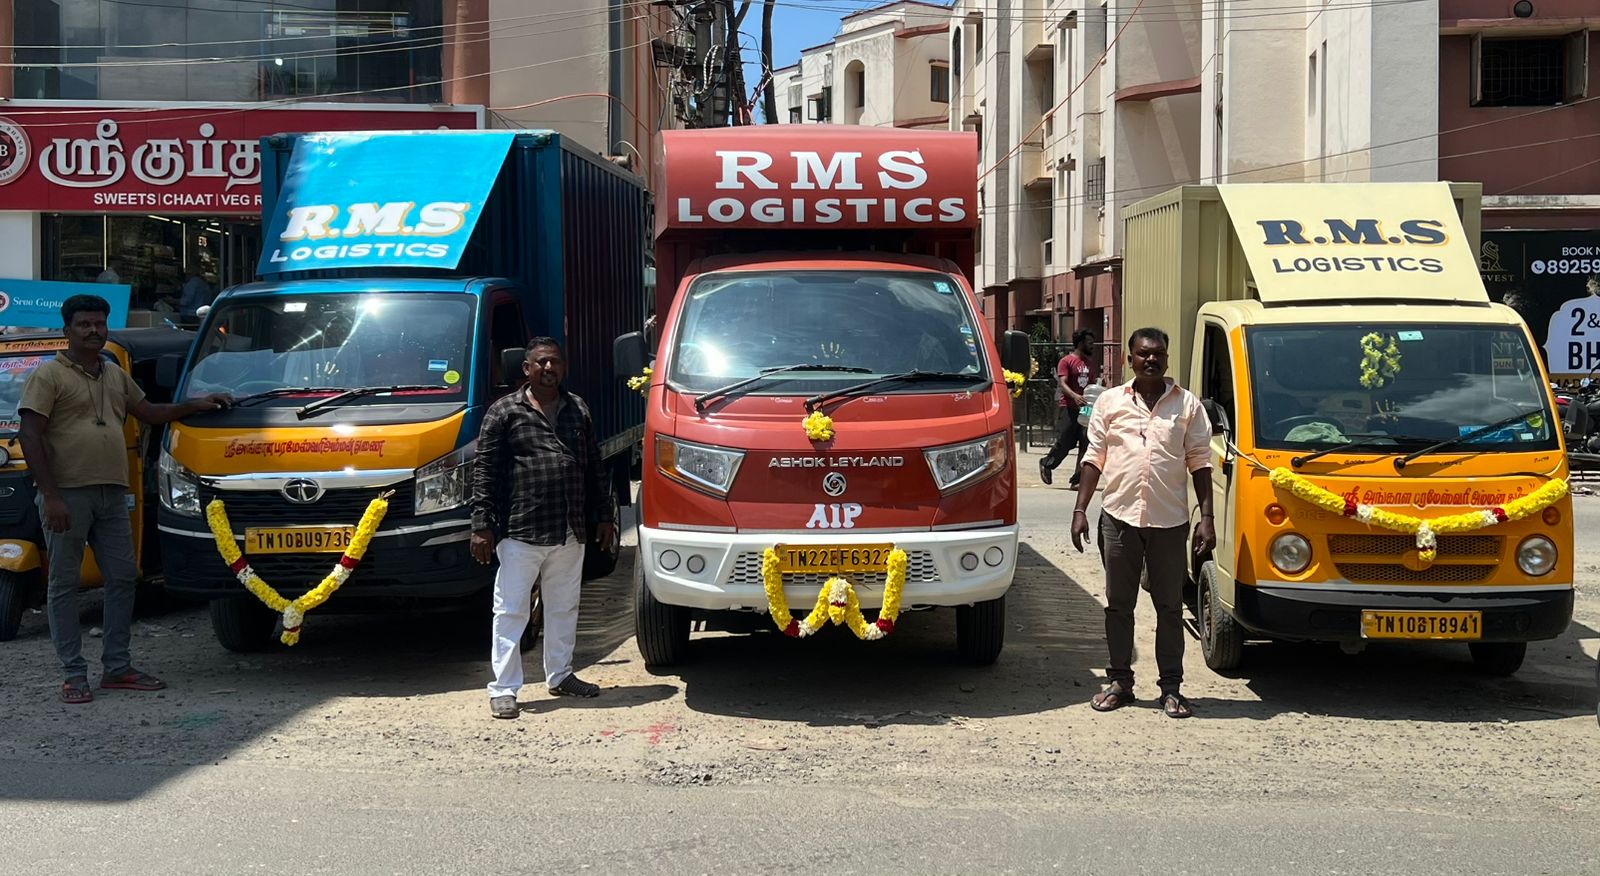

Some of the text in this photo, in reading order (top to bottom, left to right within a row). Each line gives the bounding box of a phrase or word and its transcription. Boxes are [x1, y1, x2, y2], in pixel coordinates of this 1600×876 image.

[714, 149, 929, 191] RMS
[93, 192, 157, 206] SWEETS
[162, 193, 214, 206] CHAAT
[220, 194, 250, 206] VEG
[677, 197, 967, 223] LOGISTICS
[280, 201, 470, 241] R.M.S
[1255, 218, 1449, 246] R.M.S
[269, 243, 450, 263] LOGISTICS
[1561, 246, 1594, 256] BOOK
[1272, 256, 1444, 273] LOGISTICS
[12, 296, 34, 306] Sree
[768, 456, 905, 468] ASHOK LEYLAND
[805, 502, 863, 529] AIP
[1375, 615, 1478, 634] TN10BT8941
